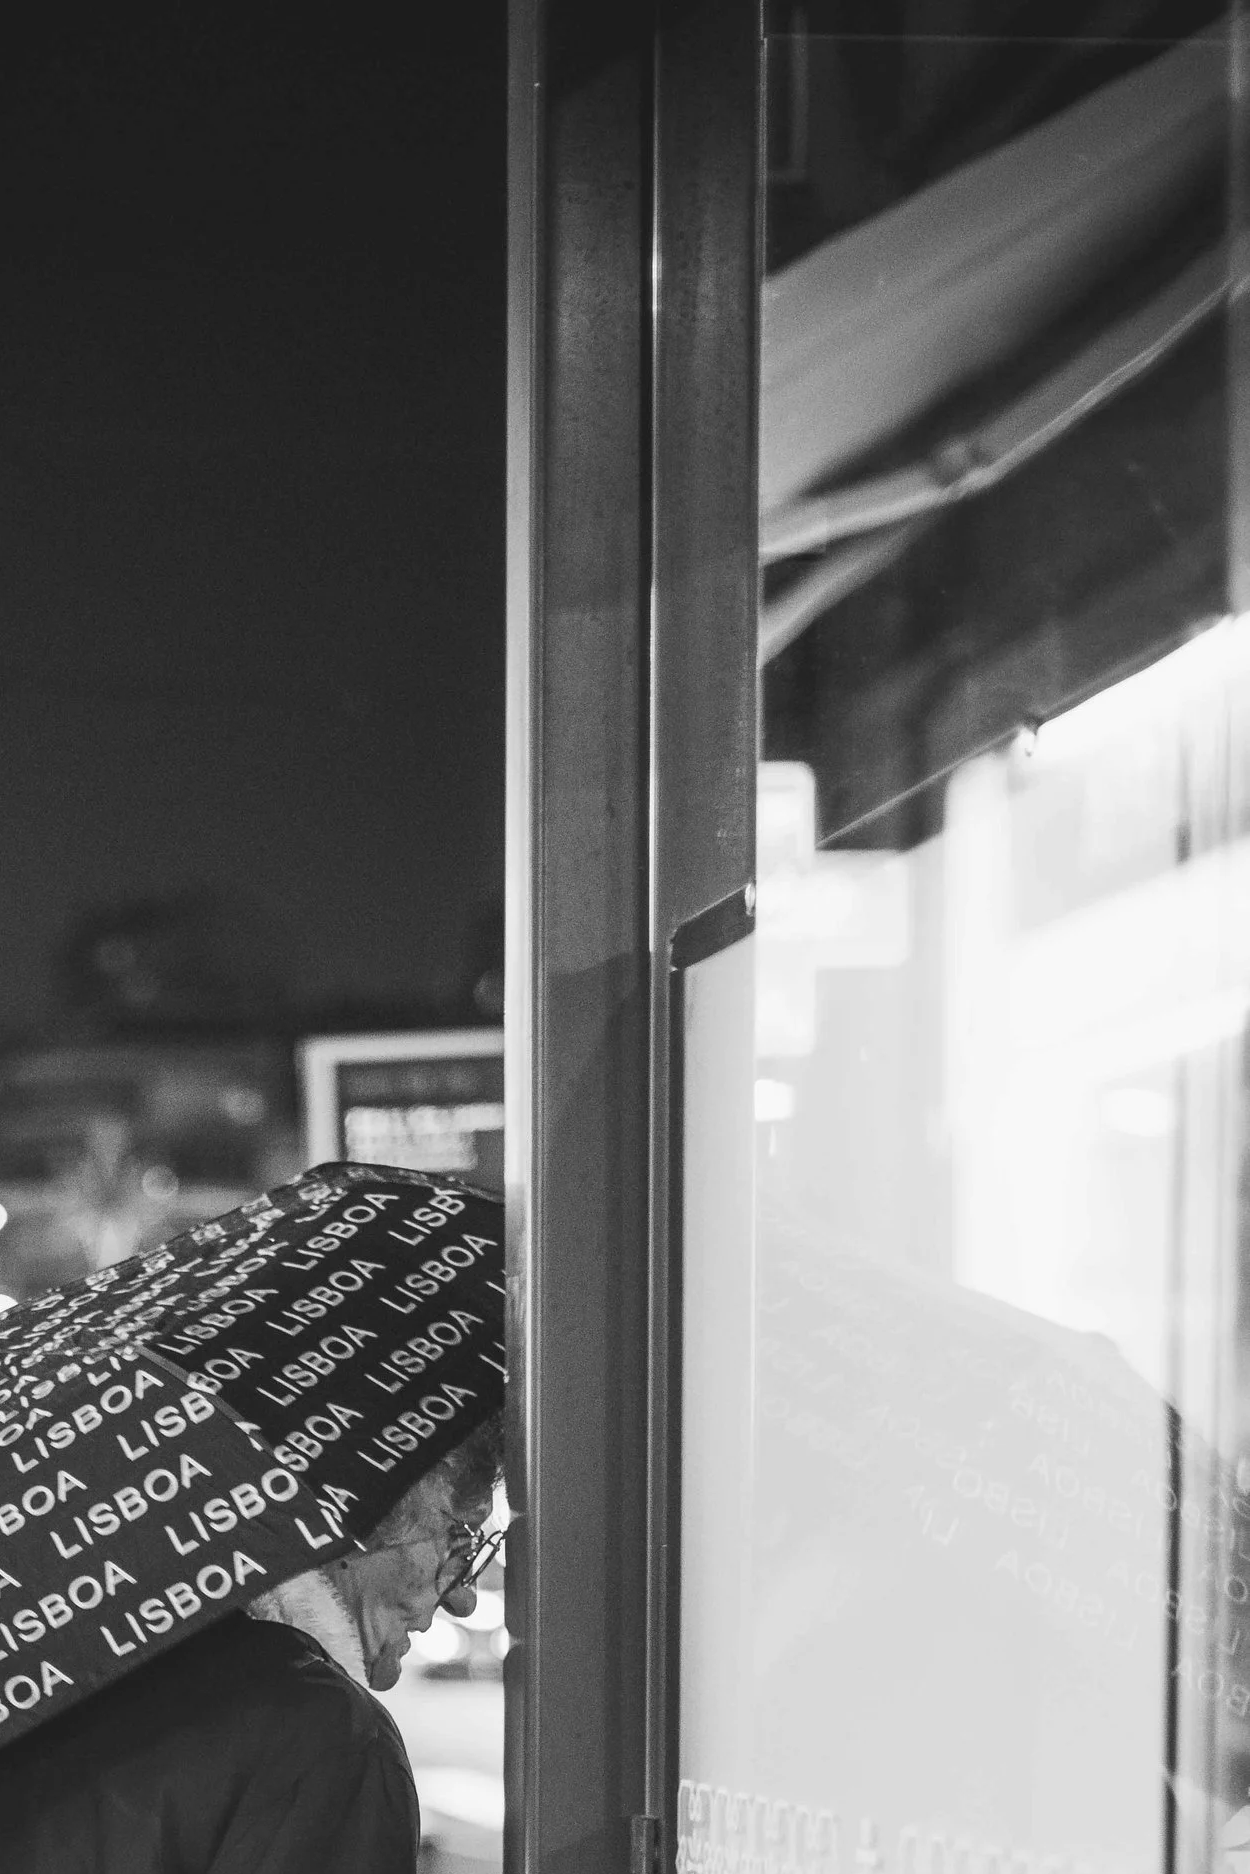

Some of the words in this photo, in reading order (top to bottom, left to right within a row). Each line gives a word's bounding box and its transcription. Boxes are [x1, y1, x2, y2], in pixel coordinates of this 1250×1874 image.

[282, 1193, 400, 1271] LISBOA
[379, 1233, 498, 1314] LISBOA
[157, 1288, 280, 1355] LISBOA
[265, 1258, 387, 1337] LISBOA
[256, 1323, 378, 1406] LISBOA
[363, 1309, 485, 1394] LISBOA
[12, 1369, 165, 1474] LISBOA
[356, 1383, 478, 1472] LISBOA
[50, 1453, 213, 1560] LISBOA
[100, 1550, 268, 1657] LISBOA
